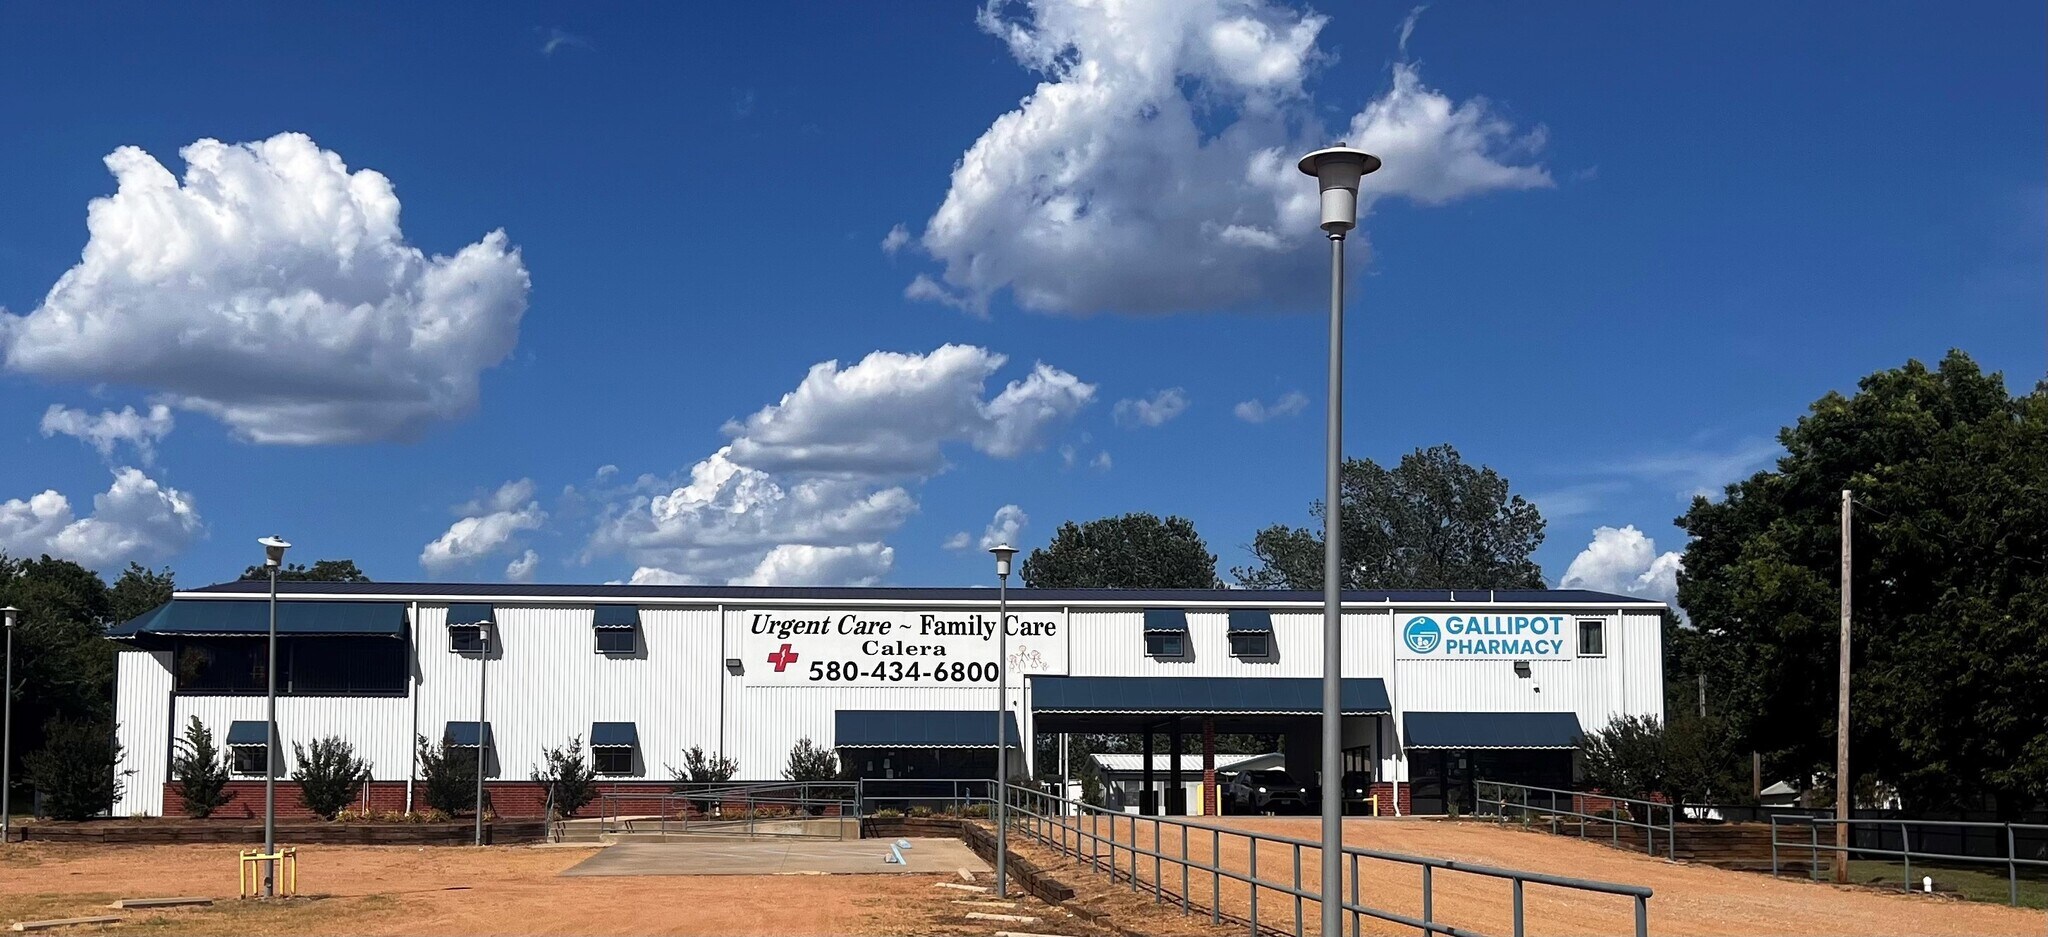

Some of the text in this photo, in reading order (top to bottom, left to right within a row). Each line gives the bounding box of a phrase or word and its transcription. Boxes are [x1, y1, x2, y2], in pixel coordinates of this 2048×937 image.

[751, 614, 831, 639] Urgent
[837, 614, 891, 635] Care
[920, 615, 997, 640] Family
[1004, 615, 1056, 636] Care
[1445, 616, 1564, 635] GALLIPOT
[861, 640, 947, 656] Calera
[1446, 639, 1564, 655] PHARMACY
[809, 661, 999, 682] 580-434-6800
